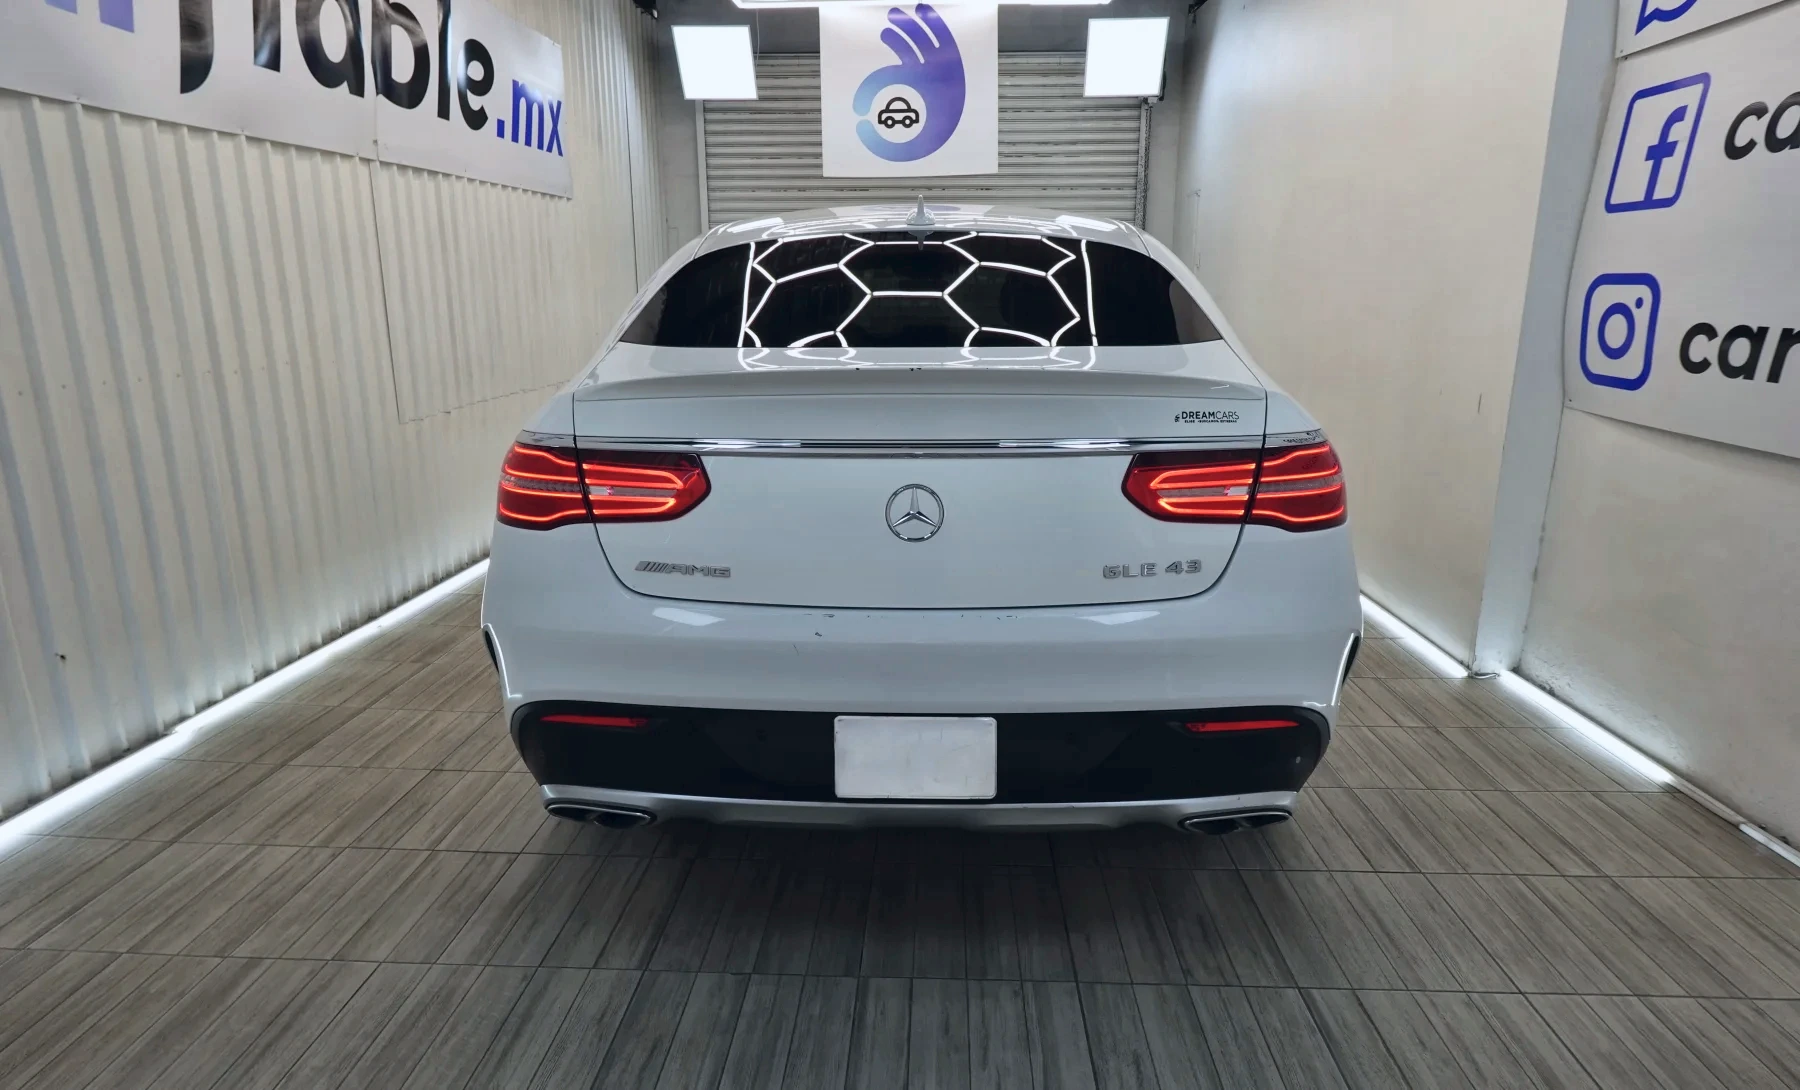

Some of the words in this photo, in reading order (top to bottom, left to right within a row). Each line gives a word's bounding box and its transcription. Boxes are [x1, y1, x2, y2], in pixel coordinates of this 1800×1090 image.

[1181, 411, 1239, 420] DREAMCARS
[664, 563, 731, 578] AMG
[1103, 564, 1158, 579] GLE
[1164, 559, 1202, 575] 43
